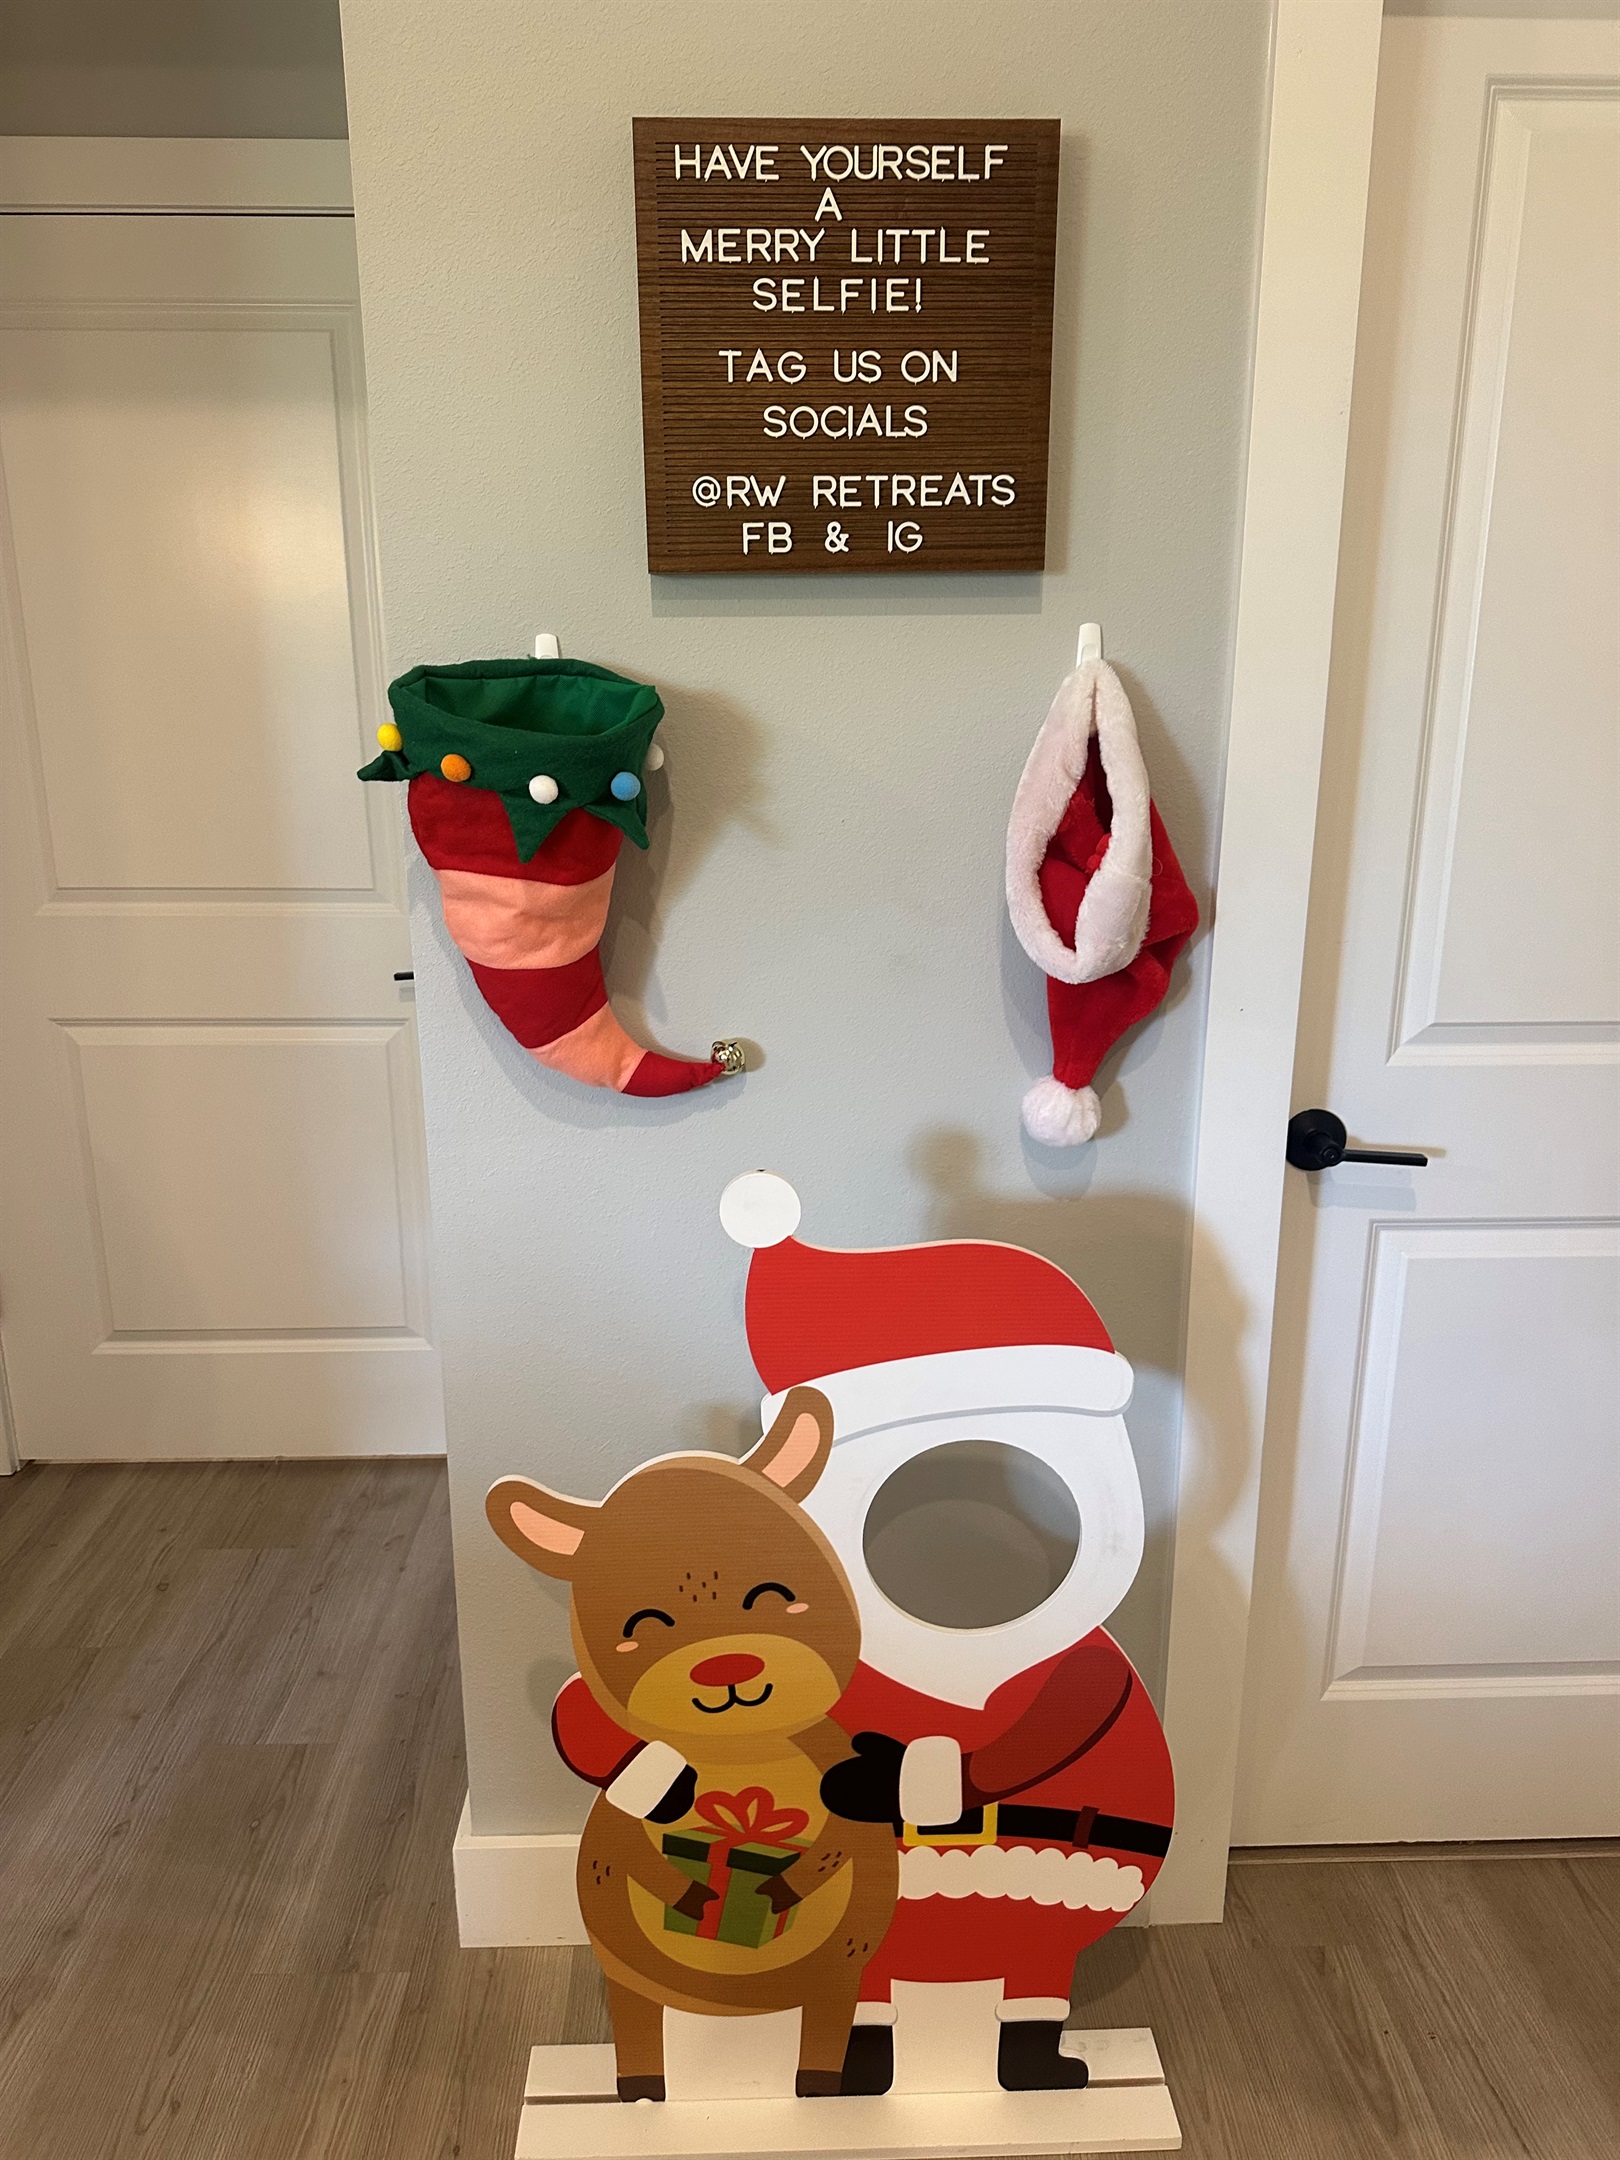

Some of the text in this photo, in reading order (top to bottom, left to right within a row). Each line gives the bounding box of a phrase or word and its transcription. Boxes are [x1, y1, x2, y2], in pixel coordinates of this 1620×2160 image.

[674, 143, 1009, 183] HAVE YOURSELF
[814, 186, 843, 222] A
[680, 226, 990, 265] MERRY LITTLE
[752, 276, 923, 314] SELFIE!
[718, 348, 958, 385] TAG US ON
[762, 403, 928, 440] SOCIALS
[691, 472, 1016, 509] @RW RETREATS
[742, 520, 924, 555] FB & IG
